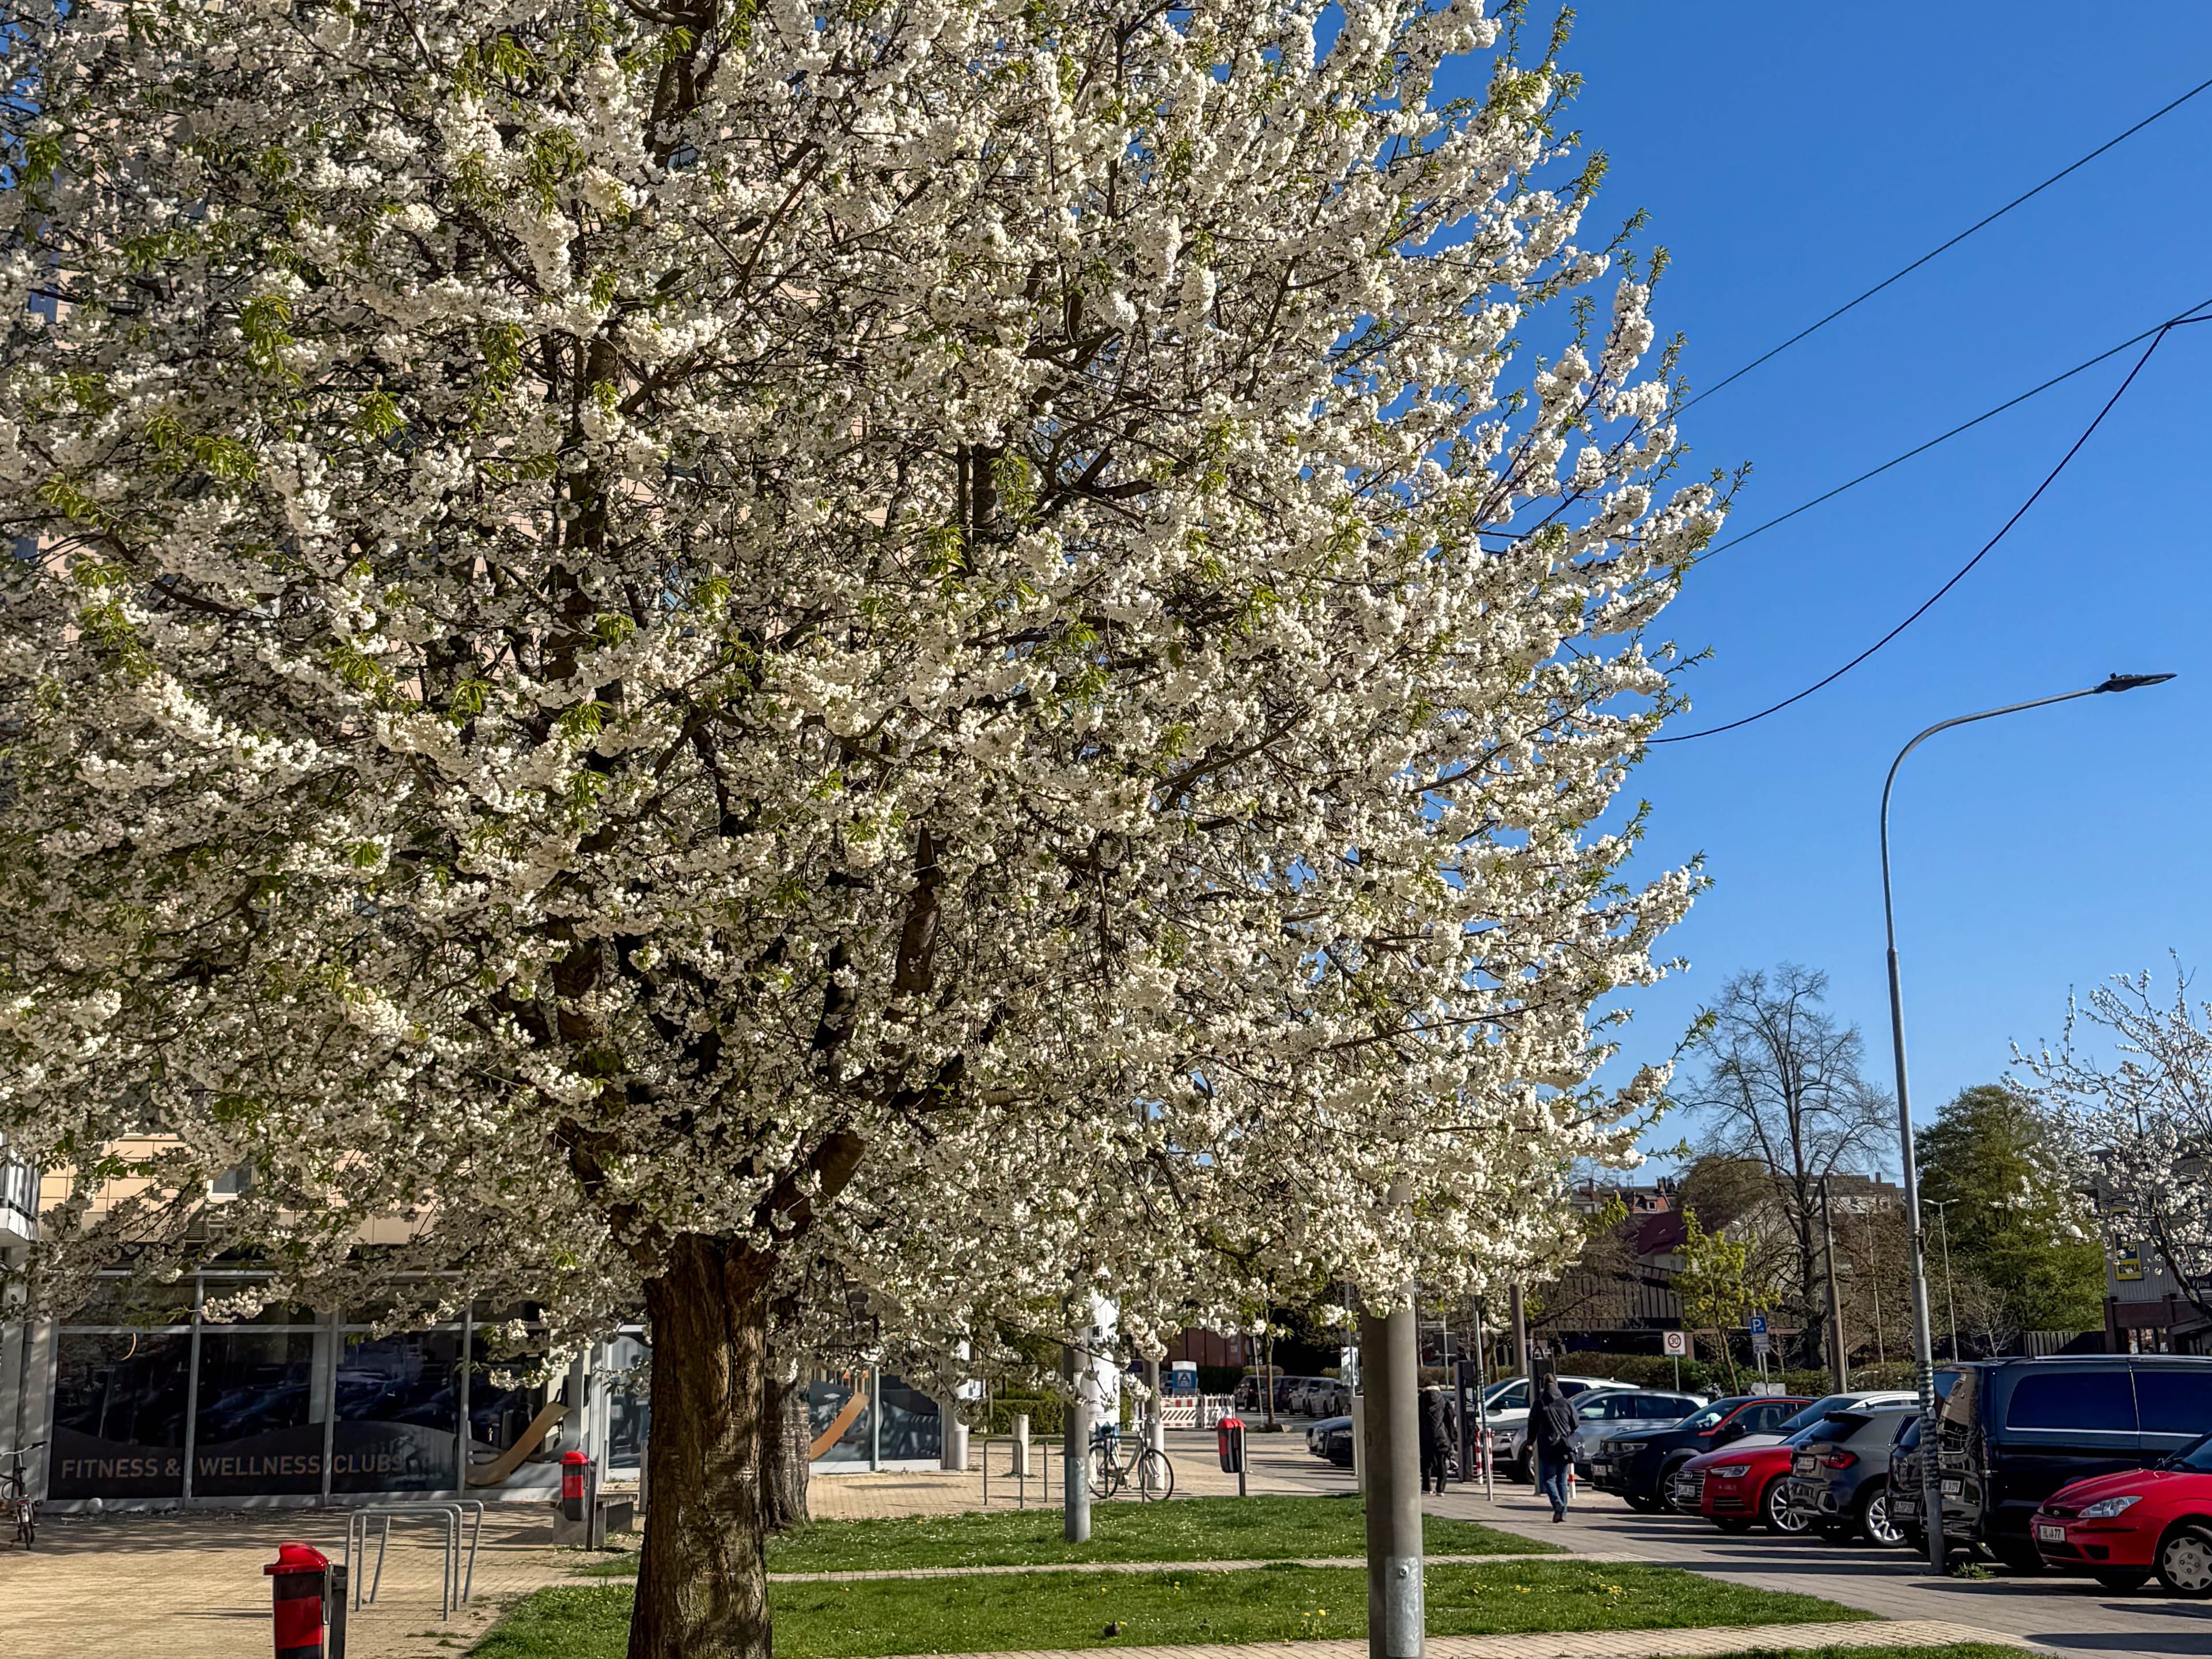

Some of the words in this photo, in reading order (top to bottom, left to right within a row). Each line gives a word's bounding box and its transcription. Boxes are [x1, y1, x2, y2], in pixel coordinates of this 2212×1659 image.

[1752, 1319, 1761, 1332] P
[61, 1458, 158, 1479] FITNESS
[165, 1458, 180, 1476] &
[199, 1455, 320, 1476] WELLNESS
